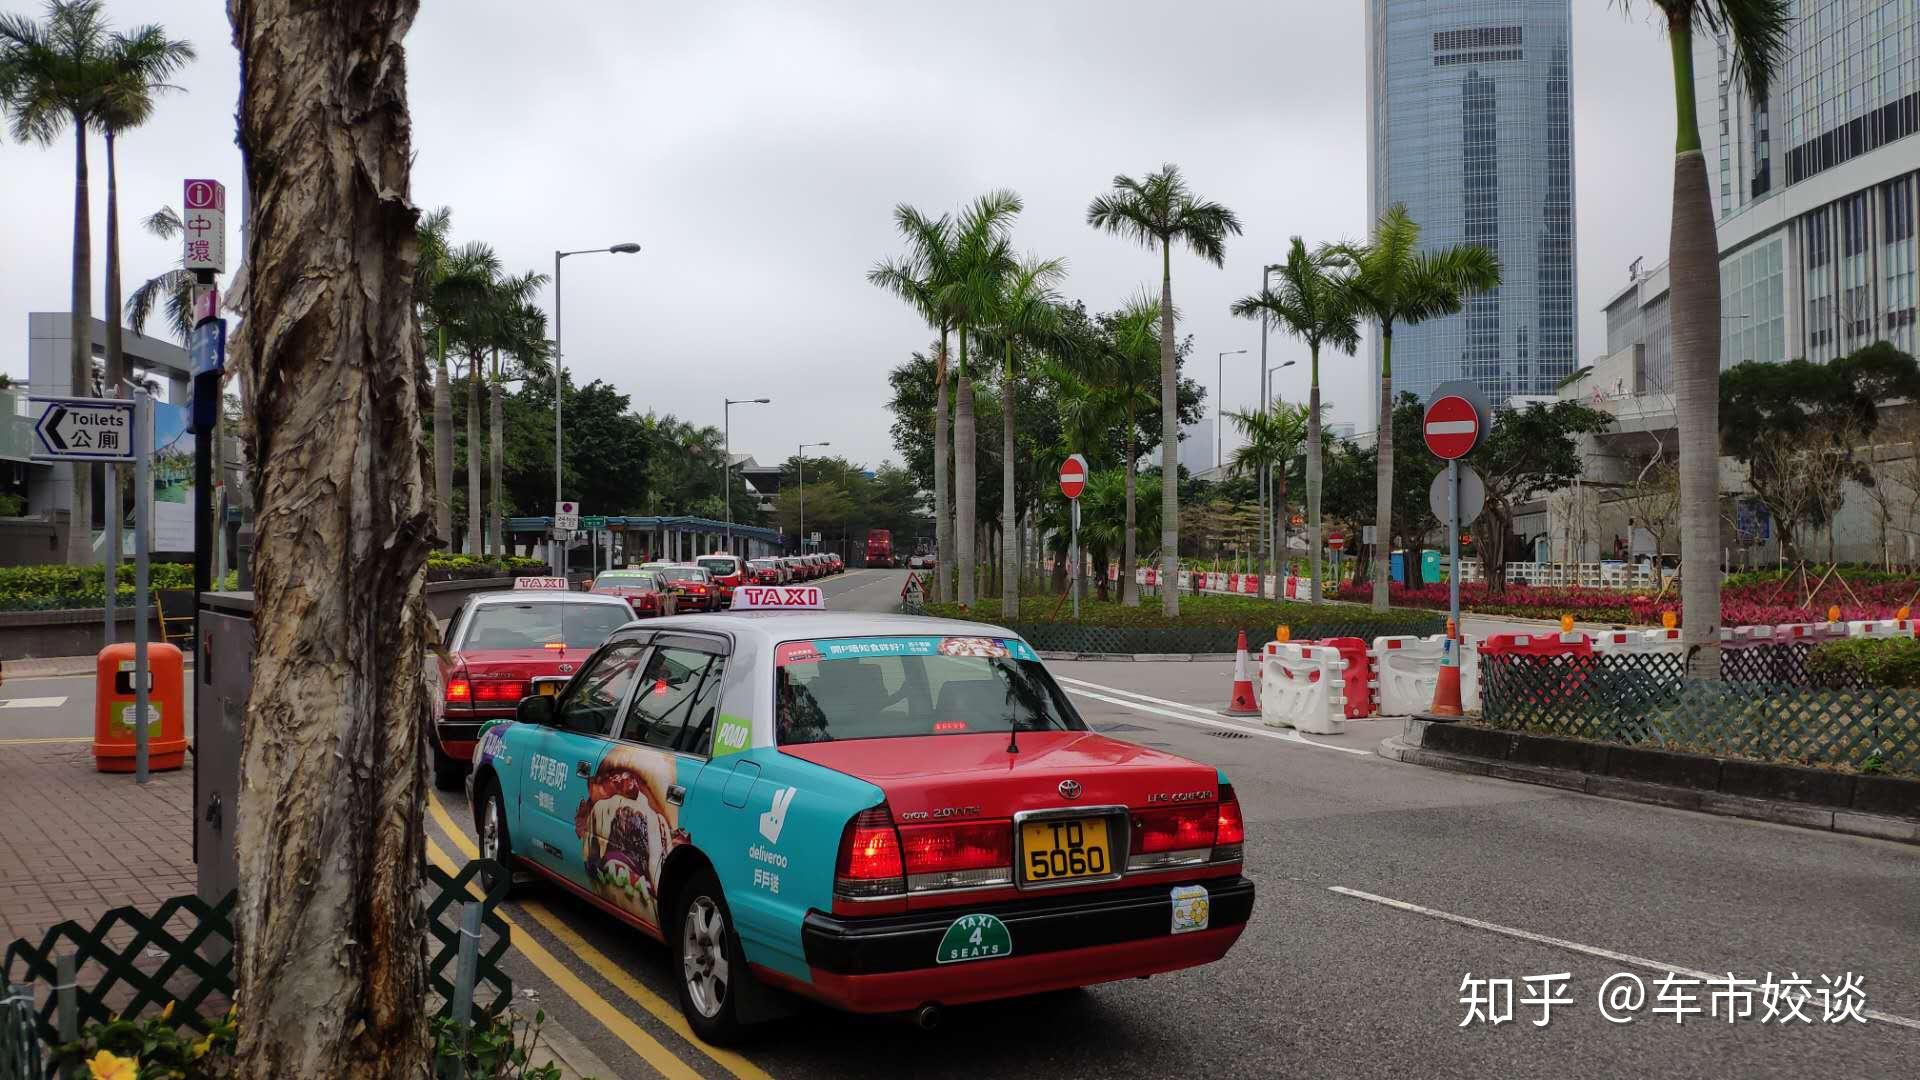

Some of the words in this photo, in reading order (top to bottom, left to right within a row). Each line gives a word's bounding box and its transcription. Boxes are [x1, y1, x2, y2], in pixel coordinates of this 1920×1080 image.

[187, 214, 212, 262] 中環
[70, 412, 124, 426] Toilets
[71, 429, 119, 449] 公廁
[520, 578, 565, 588] TAXI
[745, 588, 817, 605] TAXI
[718, 722, 749, 749] POAD
[1048, 821, 1083, 849] TD
[749, 844, 788, 868] deliveroo
[1031, 846, 1104, 878] 5060
[959, 916, 993, 930] TAXI
[969, 927, 983, 946] 4
[950, 944, 999, 959] SEATS
